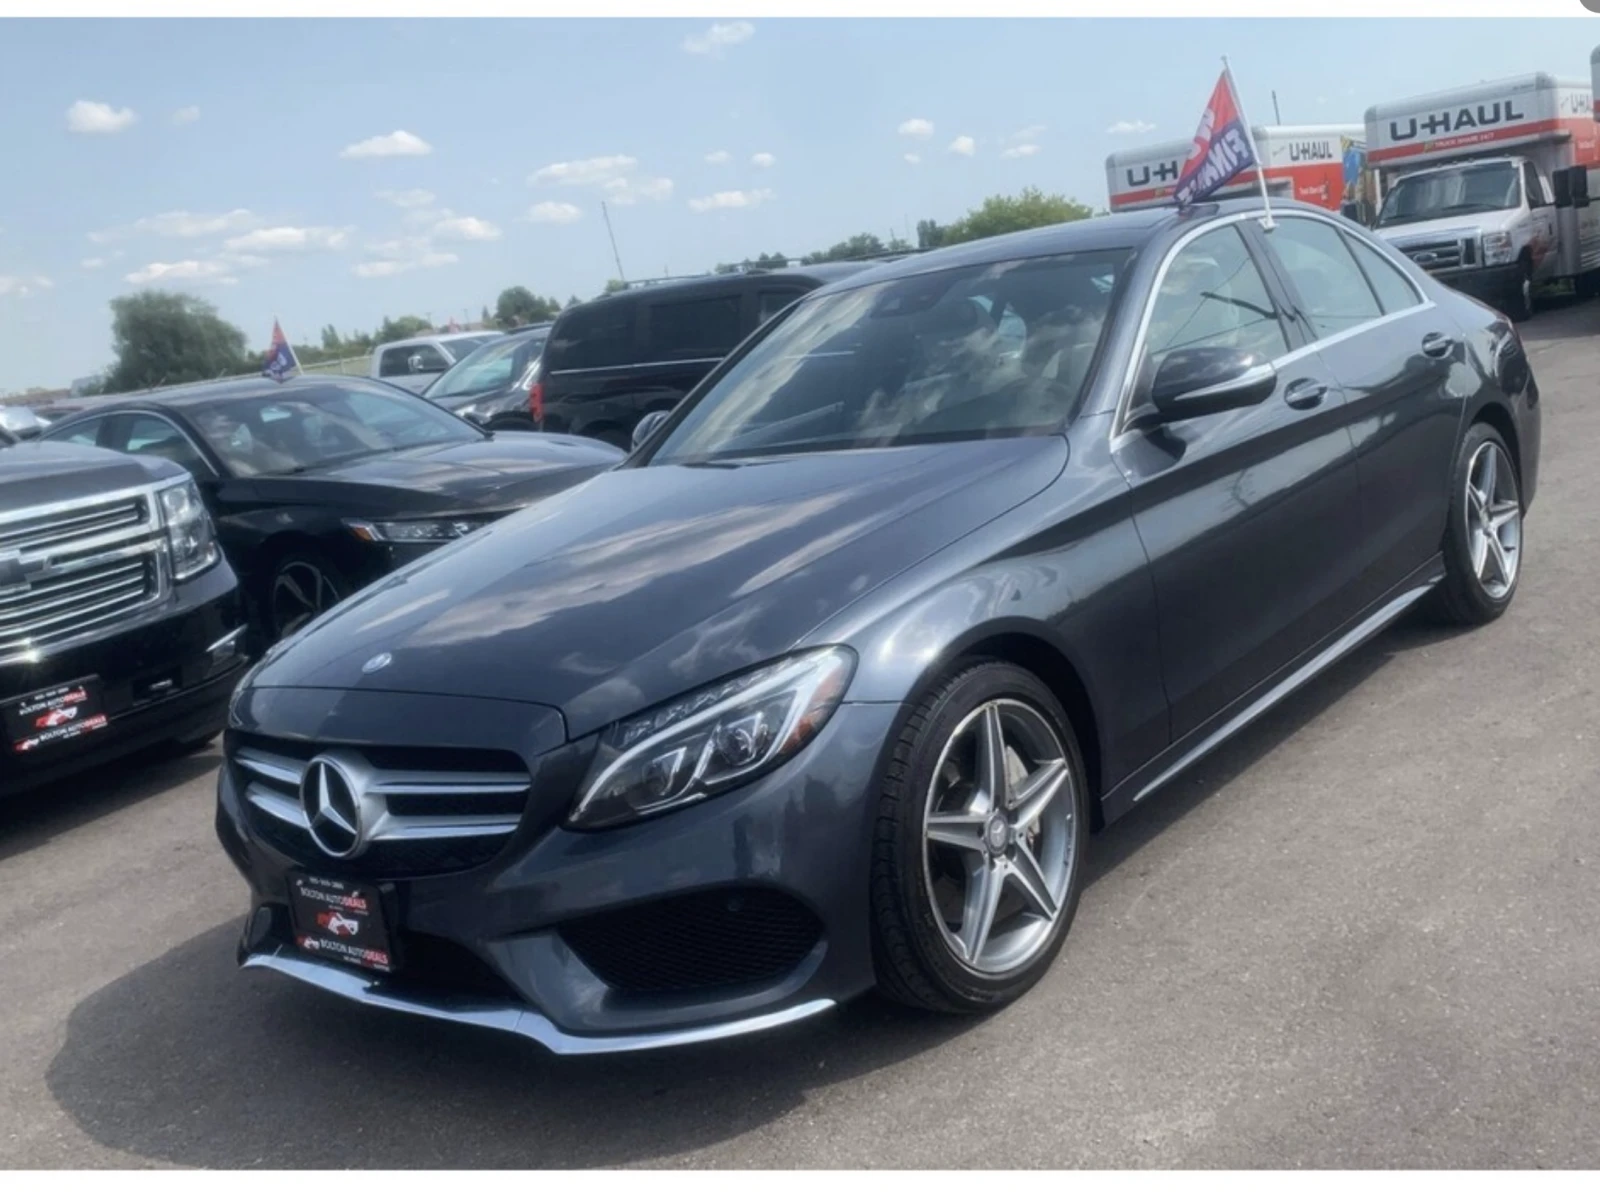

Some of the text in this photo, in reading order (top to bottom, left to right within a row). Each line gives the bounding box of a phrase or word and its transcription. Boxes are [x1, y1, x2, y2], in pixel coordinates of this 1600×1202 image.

[1390, 100, 1524, 141] U-HAUL
[1289, 141, 1333, 162] U-HAUL
[1127, 160, 1178, 187] U-H
[40, 728, 67, 741] BOLTON
[300, 887, 325, 901] BOLTON
[320, 939, 347, 953] BOLTON
